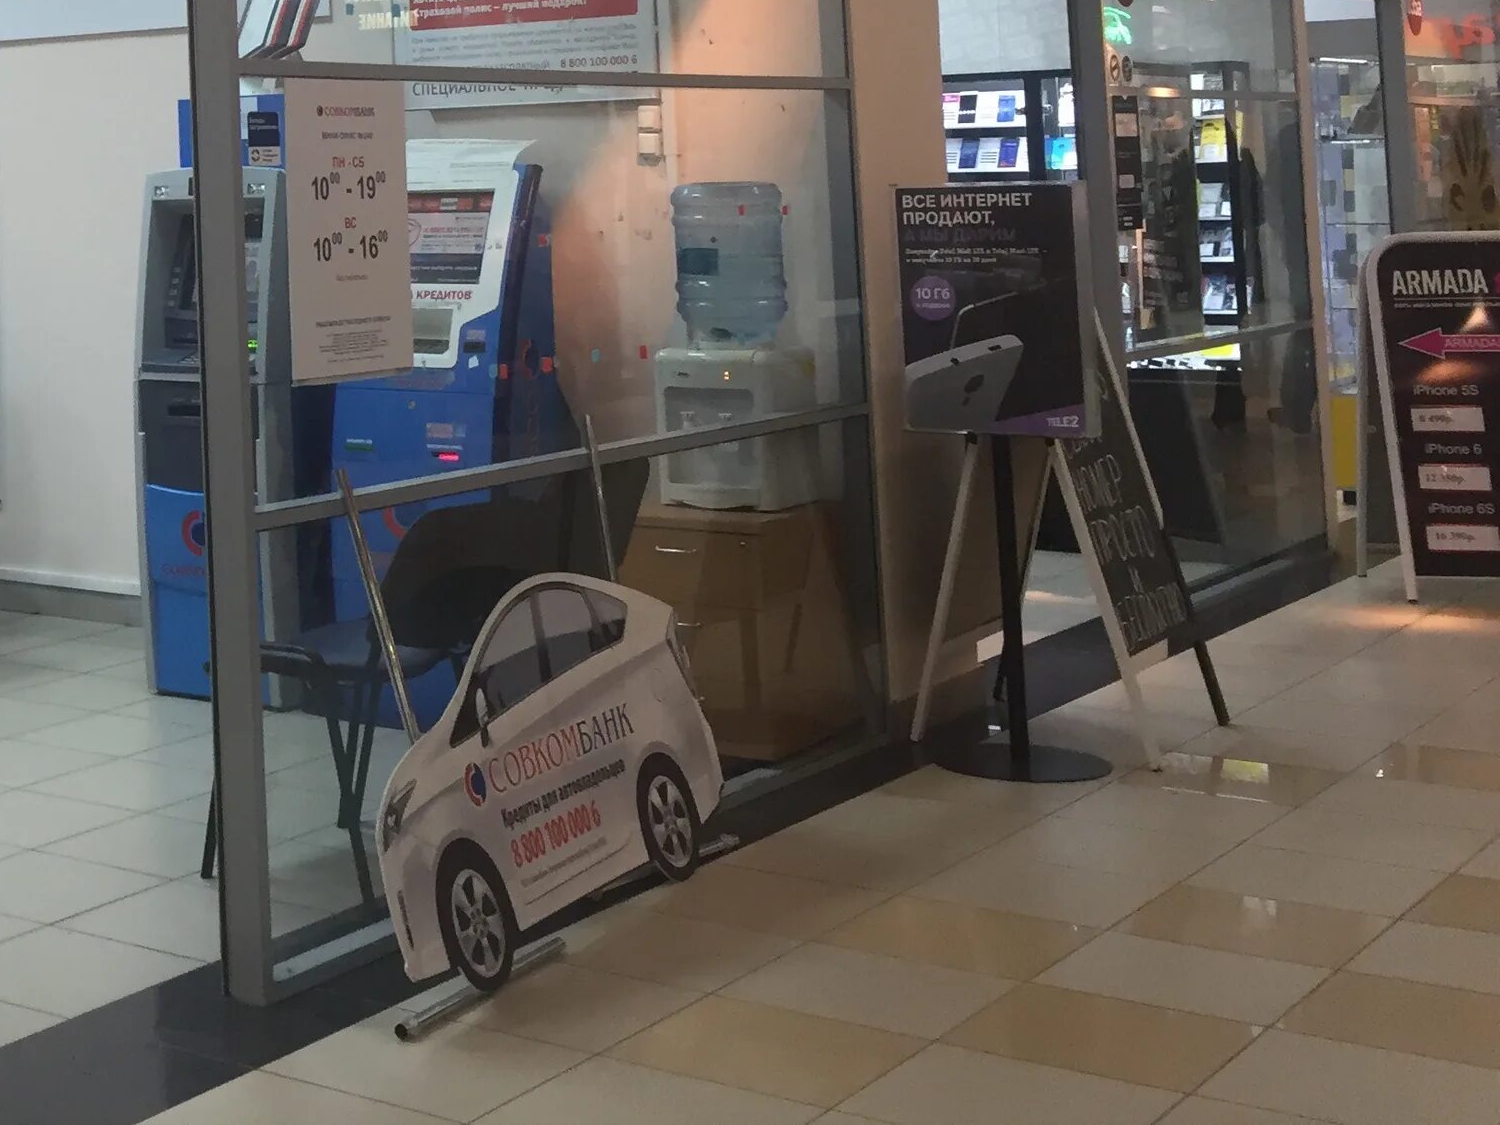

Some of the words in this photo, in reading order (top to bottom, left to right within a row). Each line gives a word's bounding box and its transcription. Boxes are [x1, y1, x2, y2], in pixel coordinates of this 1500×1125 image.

[463, 4, 493, 17] полис
[502, 0, 540, 12] лучший
[568, 57, 587, 69] 800
[589, 56, 608, 67] 100
[609, 55, 629, 66] 000
[630, 54, 638, 65] 6
[332, 156, 346, 168] ПН
[902, 194, 937, 208] ВСЕ
[940, 192, 1033, 208] ИНТЕРНЕТ
[344, 217, 357, 229] ВС
[903, 210, 996, 227] ПРОДАЮТ,
[1393, 268, 1489, 295] ARMADA
[416, 289, 474, 301] КРЕДИТОВ
[915, 287, 931, 300] 10
[1413, 384, 1458, 396] iPhone
[1461, 384, 1480, 396] 5S
[1046, 415, 1080, 428] TELE2
[1425, 443, 1470, 455] iPhone
[1473, 443, 1483, 455] 6
[1428, 502, 1474, 515] iPhone
[1476, 502, 1496, 515] 6S
[488, 703, 635, 793] СОВКОМБАНК
[510, 838, 523, 869] 8
[520, 826, 547, 864] 800
[544, 814, 570, 851] 100
[567, 803, 592, 839] 000
[590, 799, 602, 827] 6
